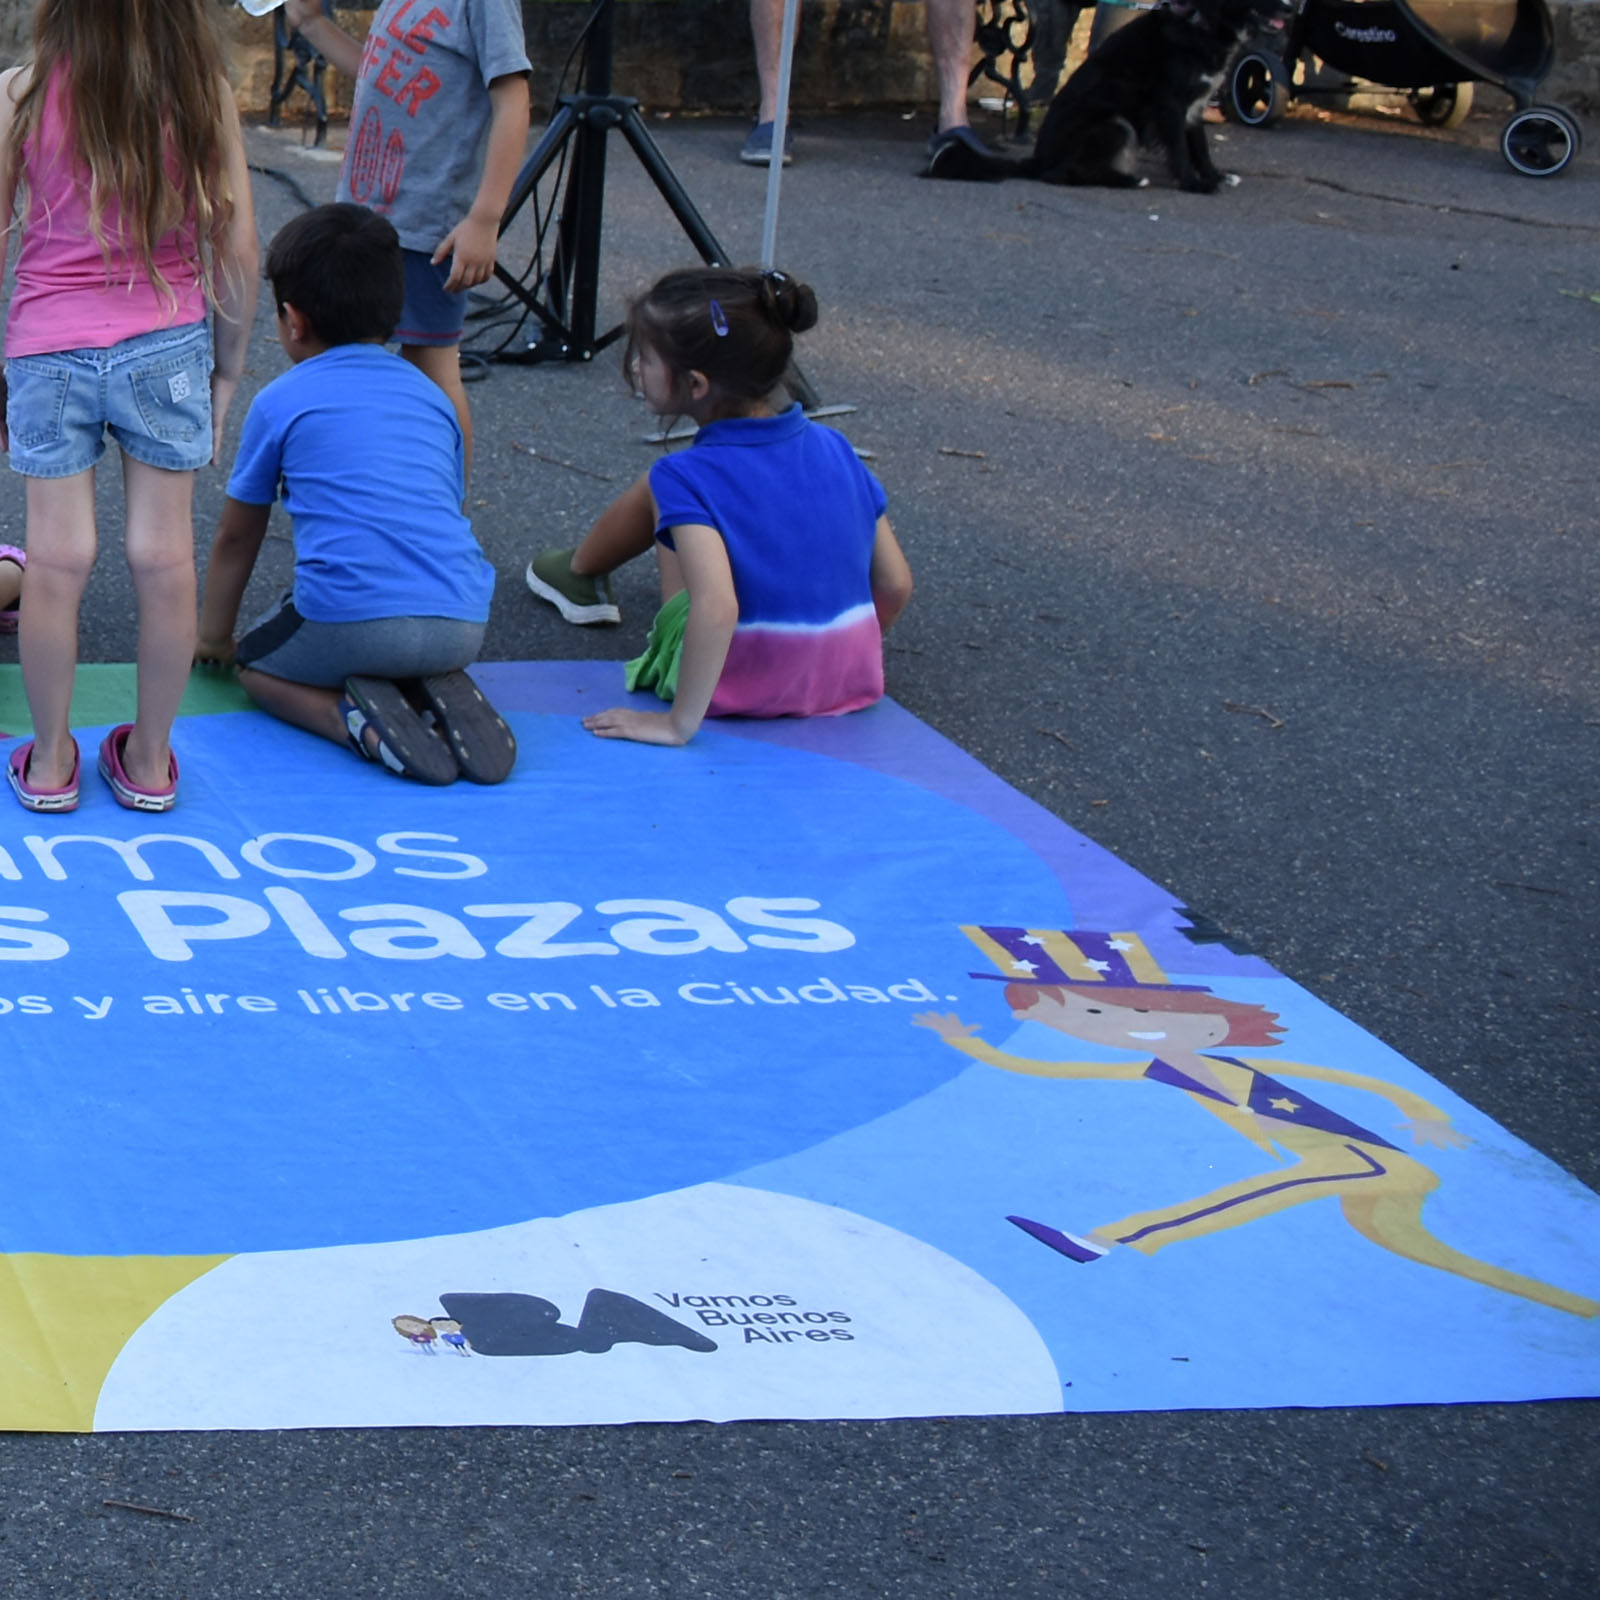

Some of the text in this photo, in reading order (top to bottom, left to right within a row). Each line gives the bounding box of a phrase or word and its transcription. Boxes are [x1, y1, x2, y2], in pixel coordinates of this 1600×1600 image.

[116, 886, 856, 961] Plazas
[73, 996, 114, 1019] y
[142, 987, 277, 1015] aire
[298, 986, 464, 1015] libre
[486, 988, 578, 1012] en
[590, 984, 661, 1008] la
[677, 977, 958, 1006] Ciudad.
[654, 1291, 798, 1309] Vamos
[438, 1288, 718, 1356] BA
[695, 1309, 852, 1326] Buenos
[742, 1325, 856, 1344] Aires
